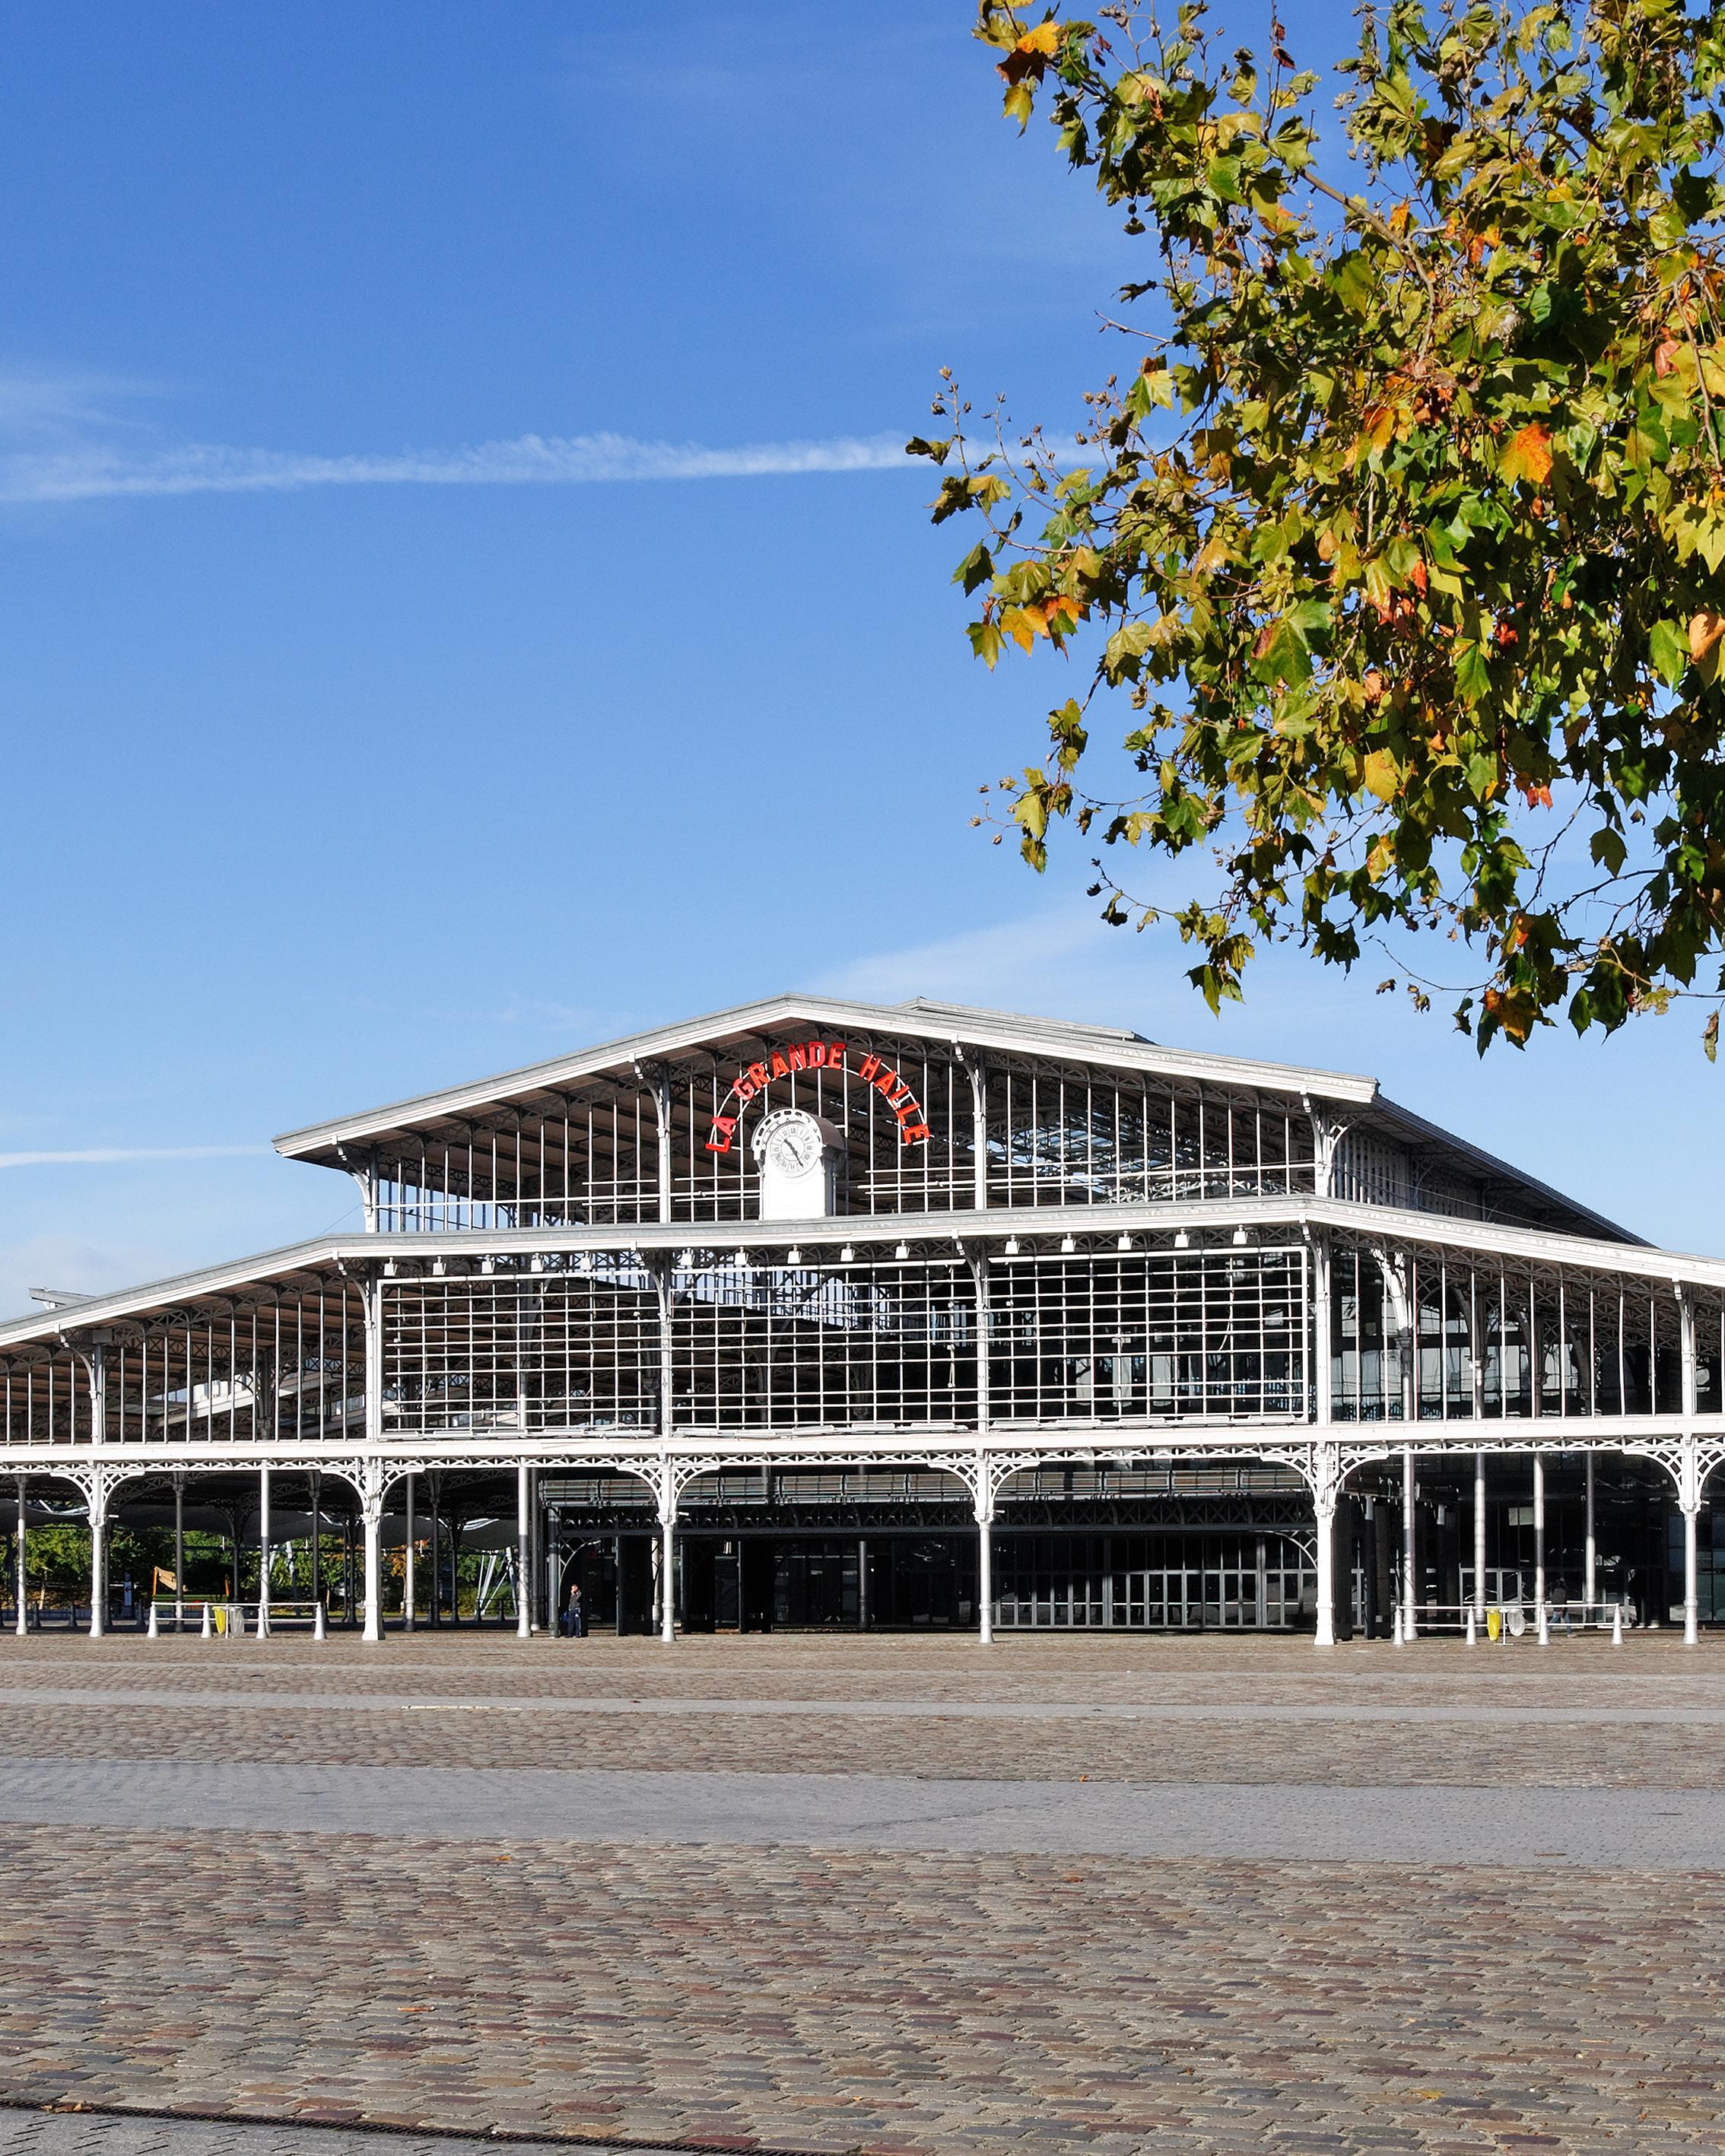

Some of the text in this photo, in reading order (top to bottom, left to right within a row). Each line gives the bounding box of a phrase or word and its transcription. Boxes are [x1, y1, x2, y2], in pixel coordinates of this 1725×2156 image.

[705, 1116, 738, 1153] LA
[732, 1040, 847, 1100] GRANDE
[859, 1054, 931, 1145] HALLE
